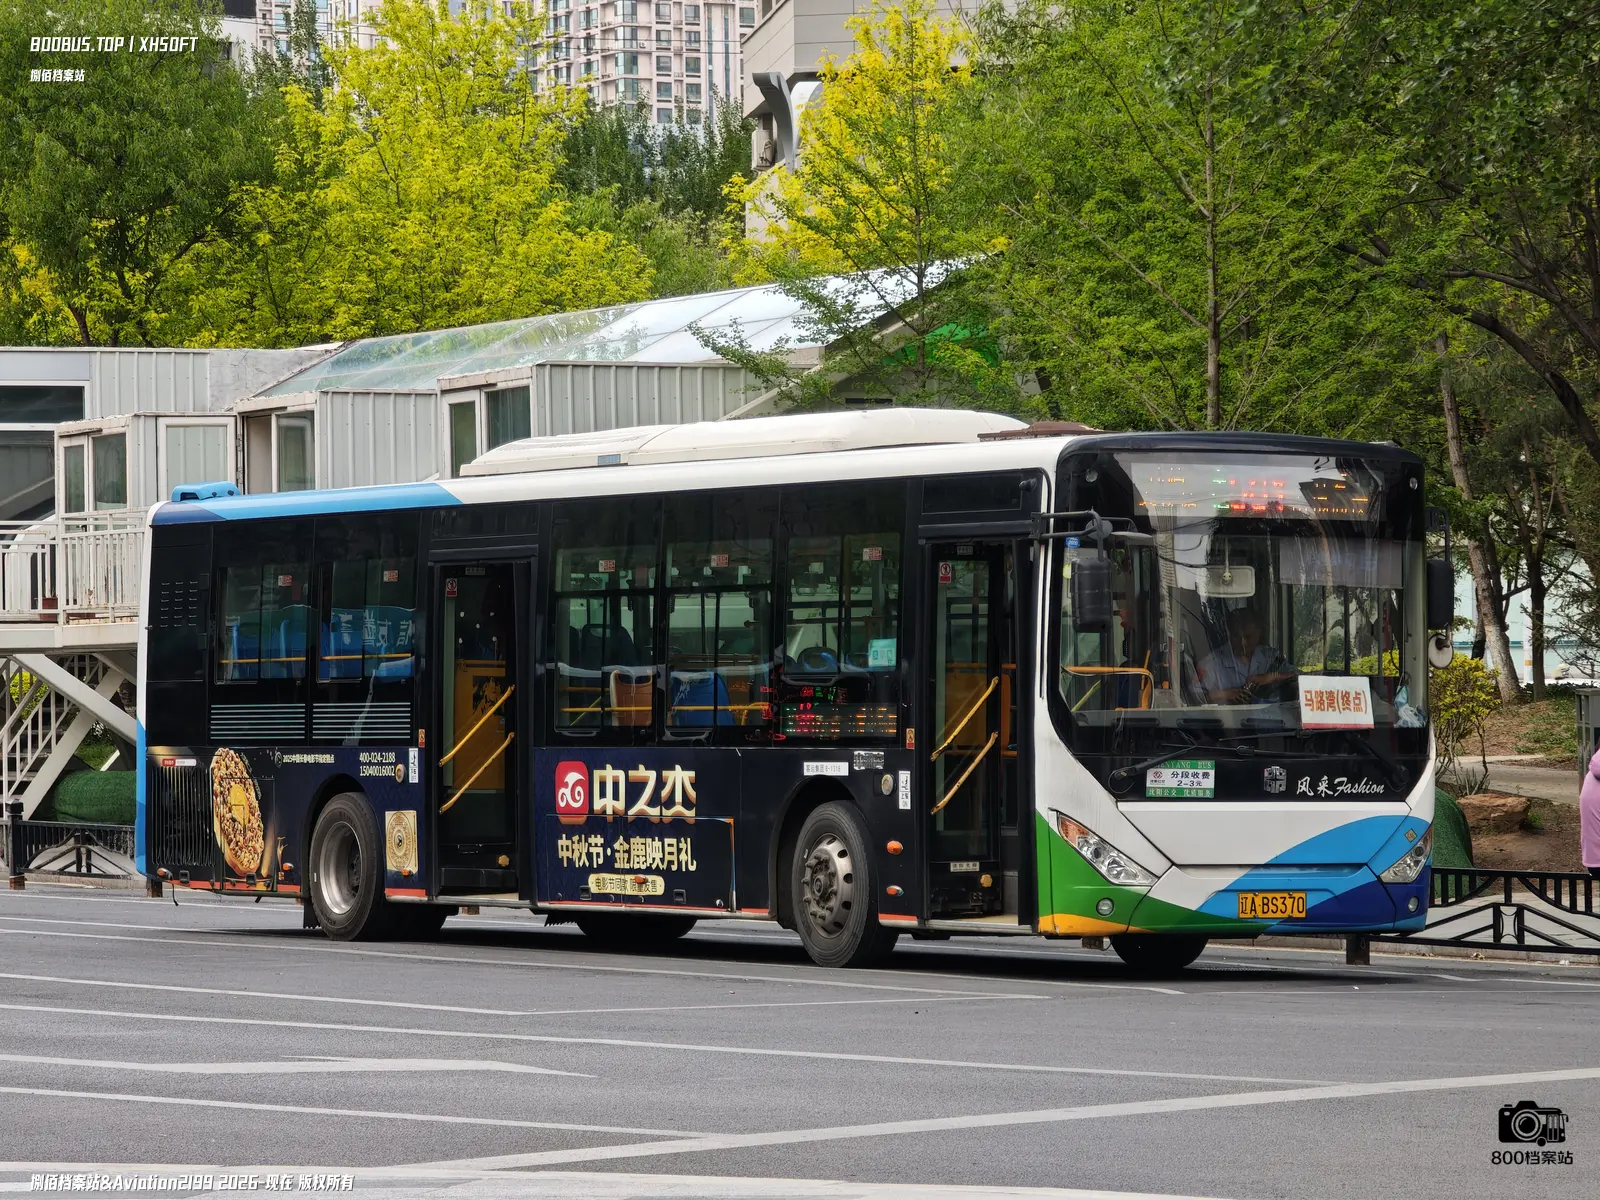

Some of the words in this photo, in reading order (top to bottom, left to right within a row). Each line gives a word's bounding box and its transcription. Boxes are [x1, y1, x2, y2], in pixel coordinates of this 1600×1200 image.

[1304, 689, 1367, 714] 马路湾(终点)
[359, 752, 395, 764] 400-024-2188
[359, 765, 395, 777] 15040016002
[1198, 761, 1212, 769] BUS
[1170, 770, 1211, 780] 分段收费
[593, 763, 697, 825] 中之杰
[1149, 788, 1177, 797] 沈阳公交
[1183, 788, 1212, 798] 优质服务
